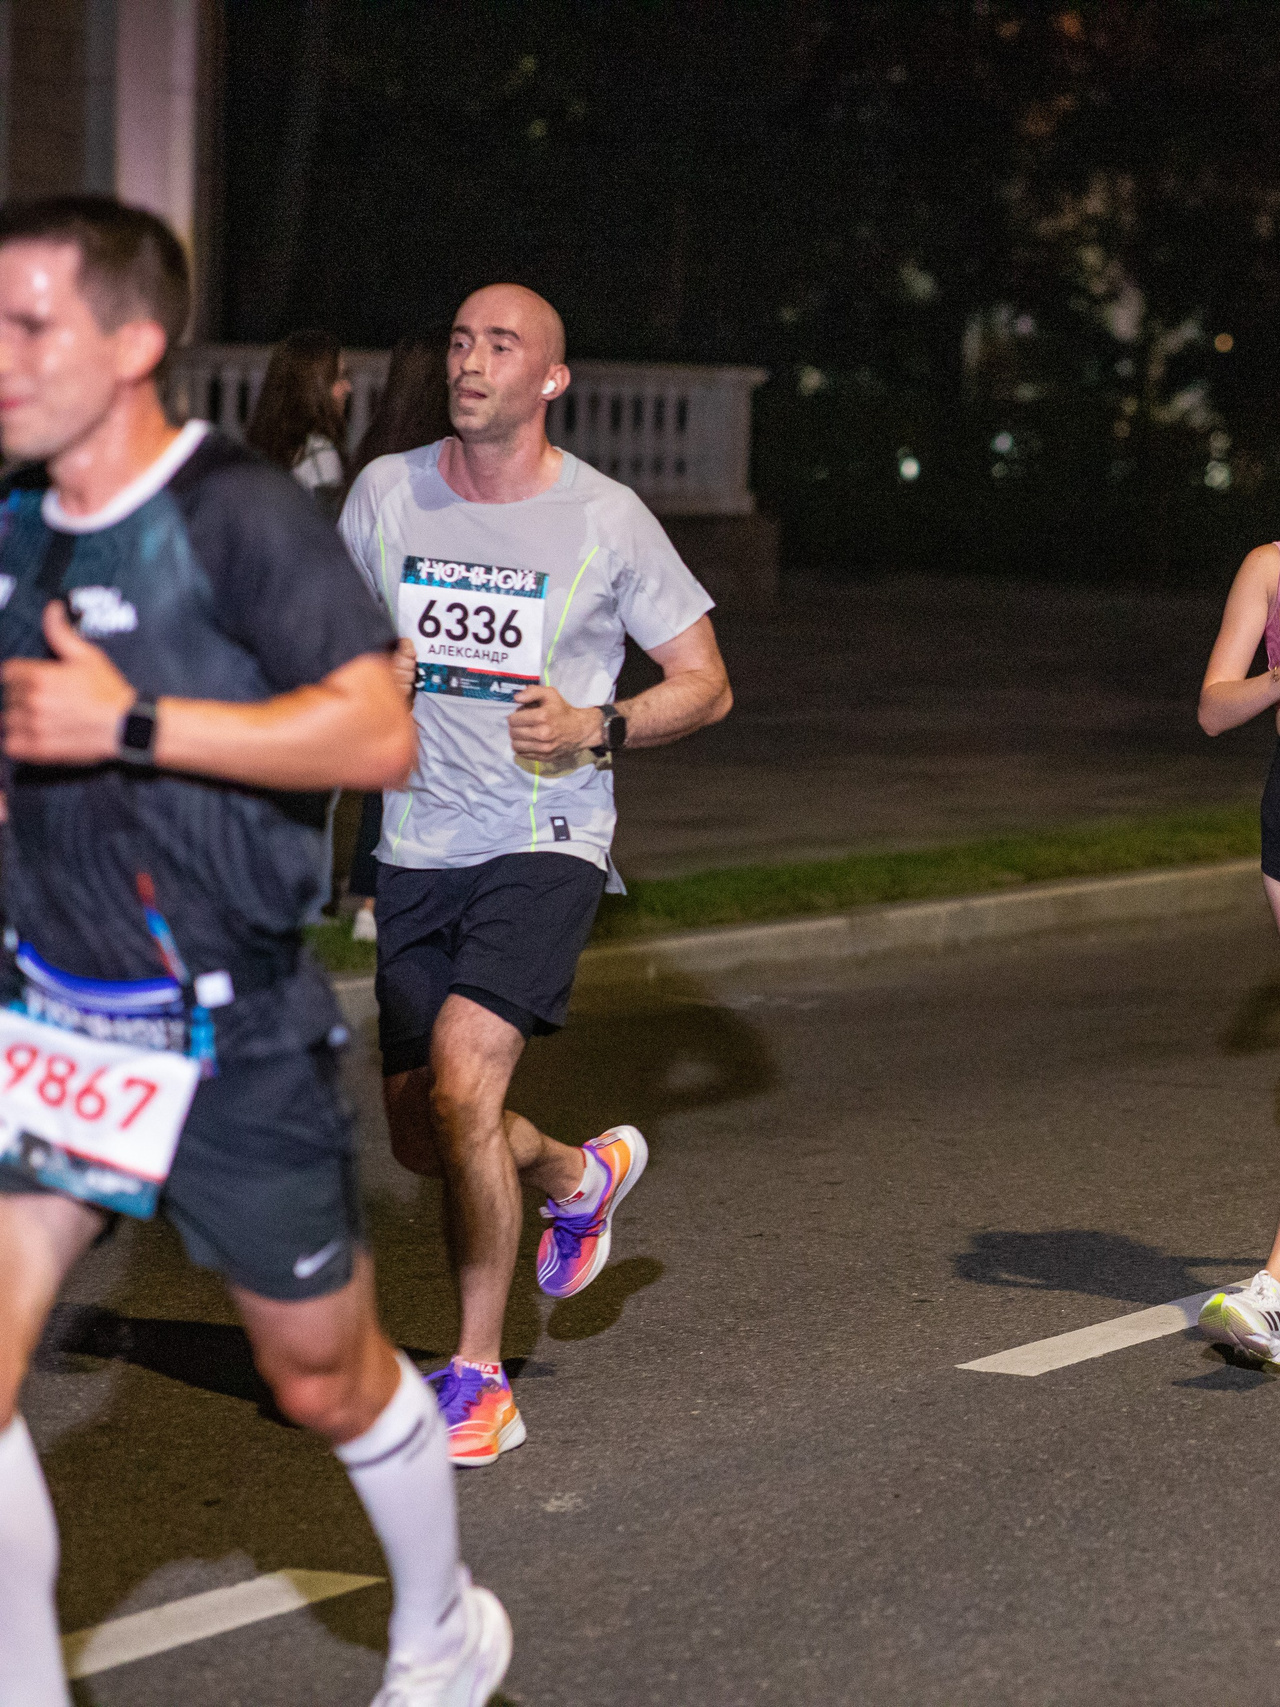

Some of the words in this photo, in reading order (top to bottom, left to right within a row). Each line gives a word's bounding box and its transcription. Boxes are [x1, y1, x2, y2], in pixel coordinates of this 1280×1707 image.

[417, 558, 536, 591] НОЧНОЙ
[418, 600, 522, 648] 6336
[428, 644, 509, 664] АЛЕКСАНДР
[3, 1043, 157, 1129] 9867
